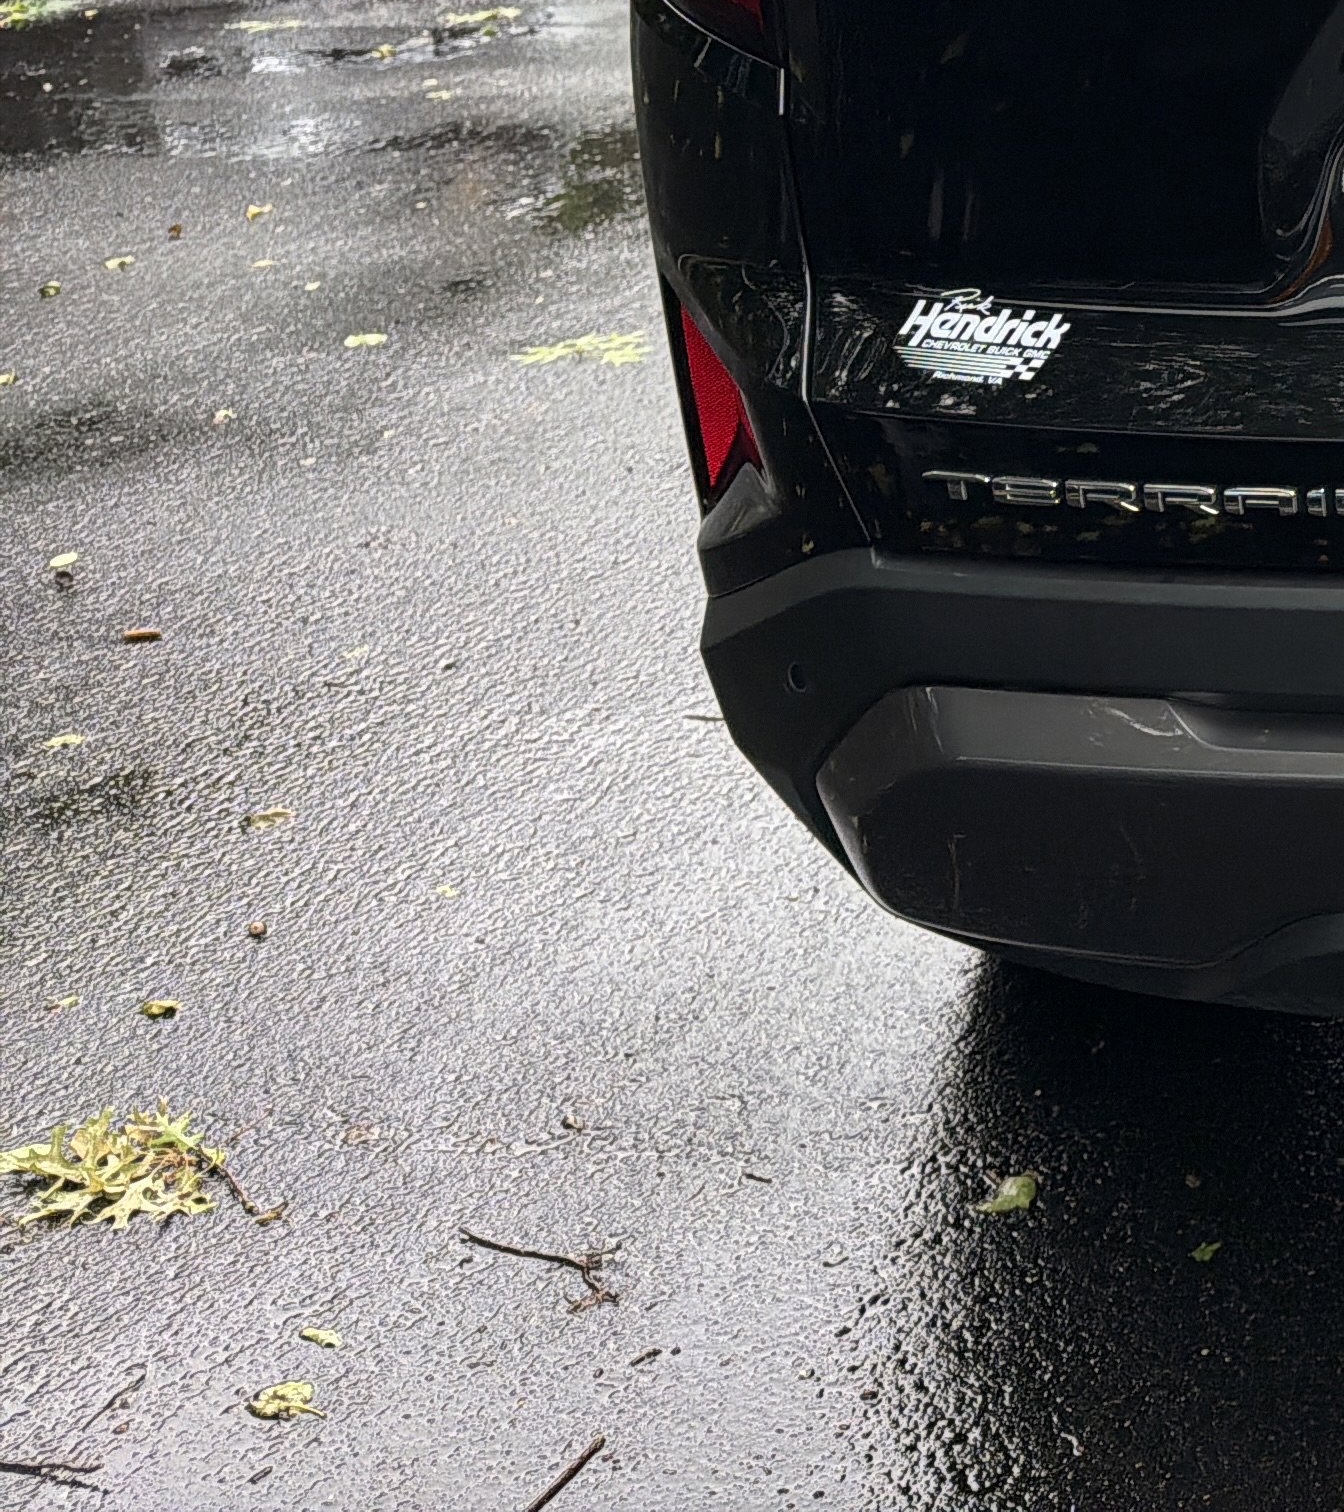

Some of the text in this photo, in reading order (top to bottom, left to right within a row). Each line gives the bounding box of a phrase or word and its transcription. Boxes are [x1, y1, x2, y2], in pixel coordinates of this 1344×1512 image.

[898, 299, 1071, 349] Hendrick
[921, 338, 1051, 360] CHEVROLET BUICK GMC
[987, 376, 1002, 385] VA
